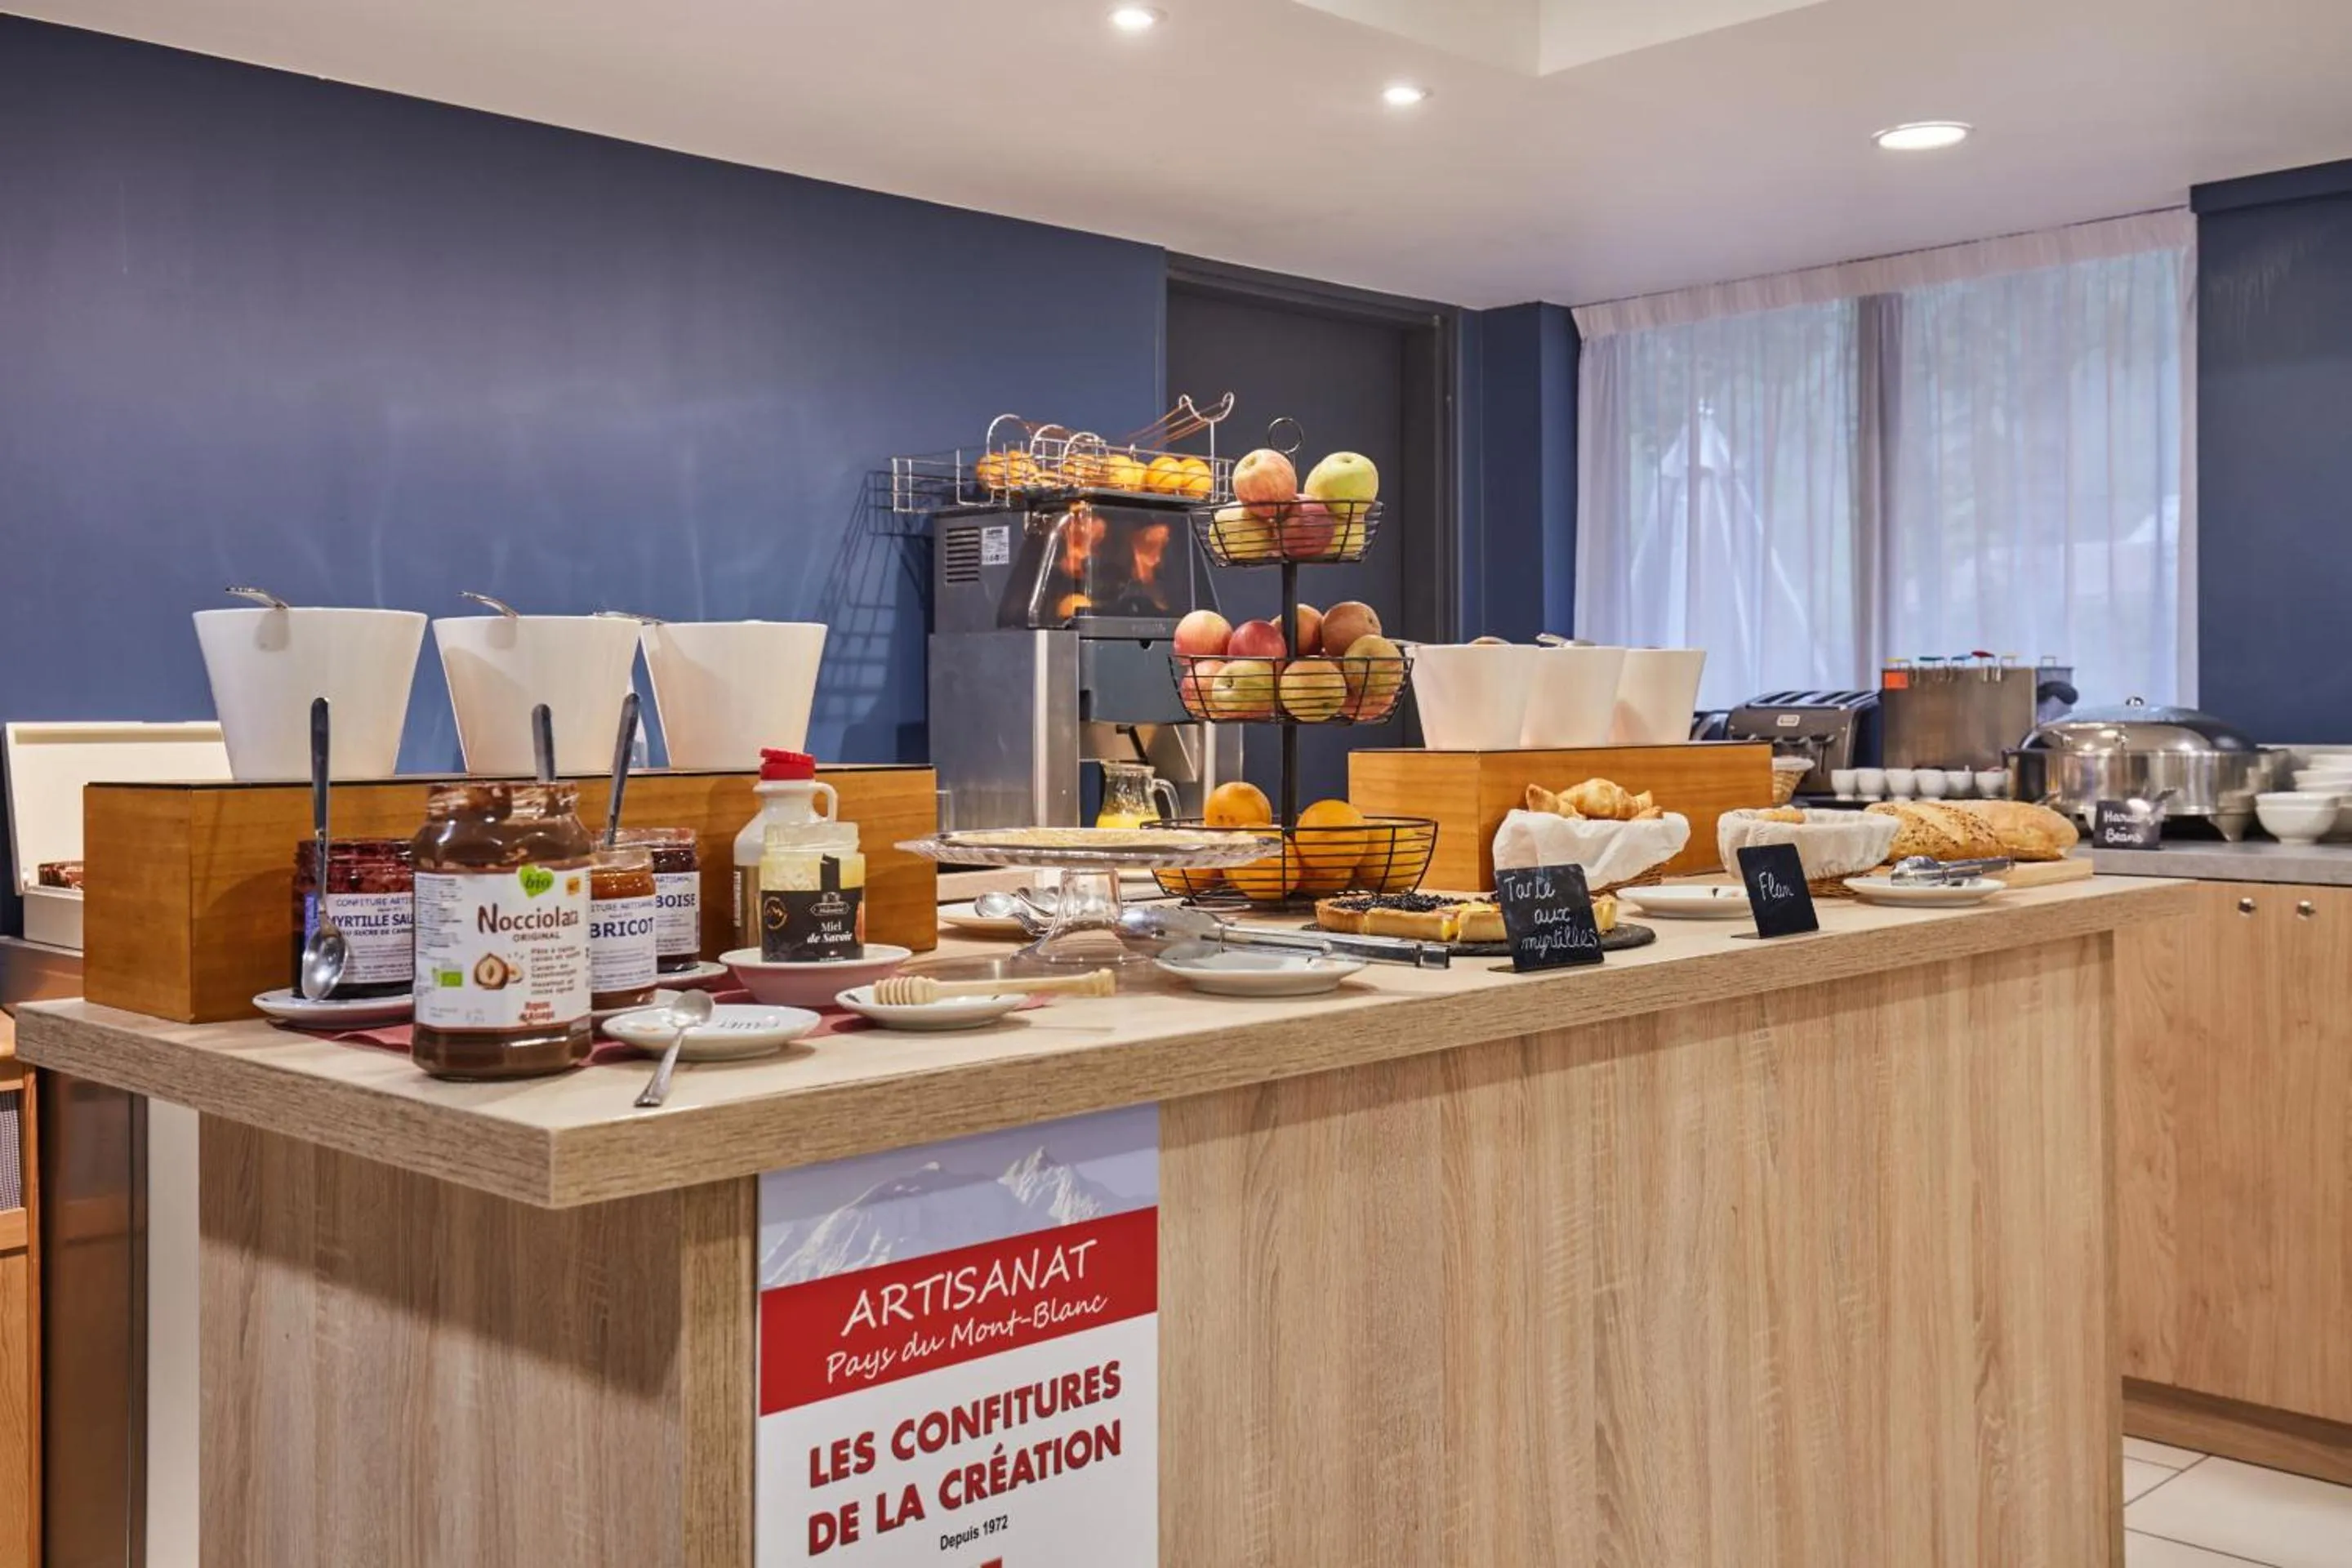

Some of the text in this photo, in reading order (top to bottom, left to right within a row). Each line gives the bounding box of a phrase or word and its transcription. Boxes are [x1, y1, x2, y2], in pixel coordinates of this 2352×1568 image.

[525, 873, 550, 889] bio
[1503, 875, 1556, 902] Tarte
[1758, 871, 1794, 902] Flan
[336, 898, 387, 907] CONFITURE
[1535, 907, 1570, 924] aux
[512, 931, 561, 942] ORIGINAL
[806, 933, 821, 944] de
[821, 920, 842, 932] Miel
[841, 1239, 1098, 1337] ARTISANAT
[826, 1294, 1108, 1384] Pays du Mont-Blanc
[809, 1360, 1121, 1489] LES CONFITURES
[808, 1419, 1121, 1557] DE LA CRÉATION
[940, 1514, 1009, 1551] Depuis 1972
